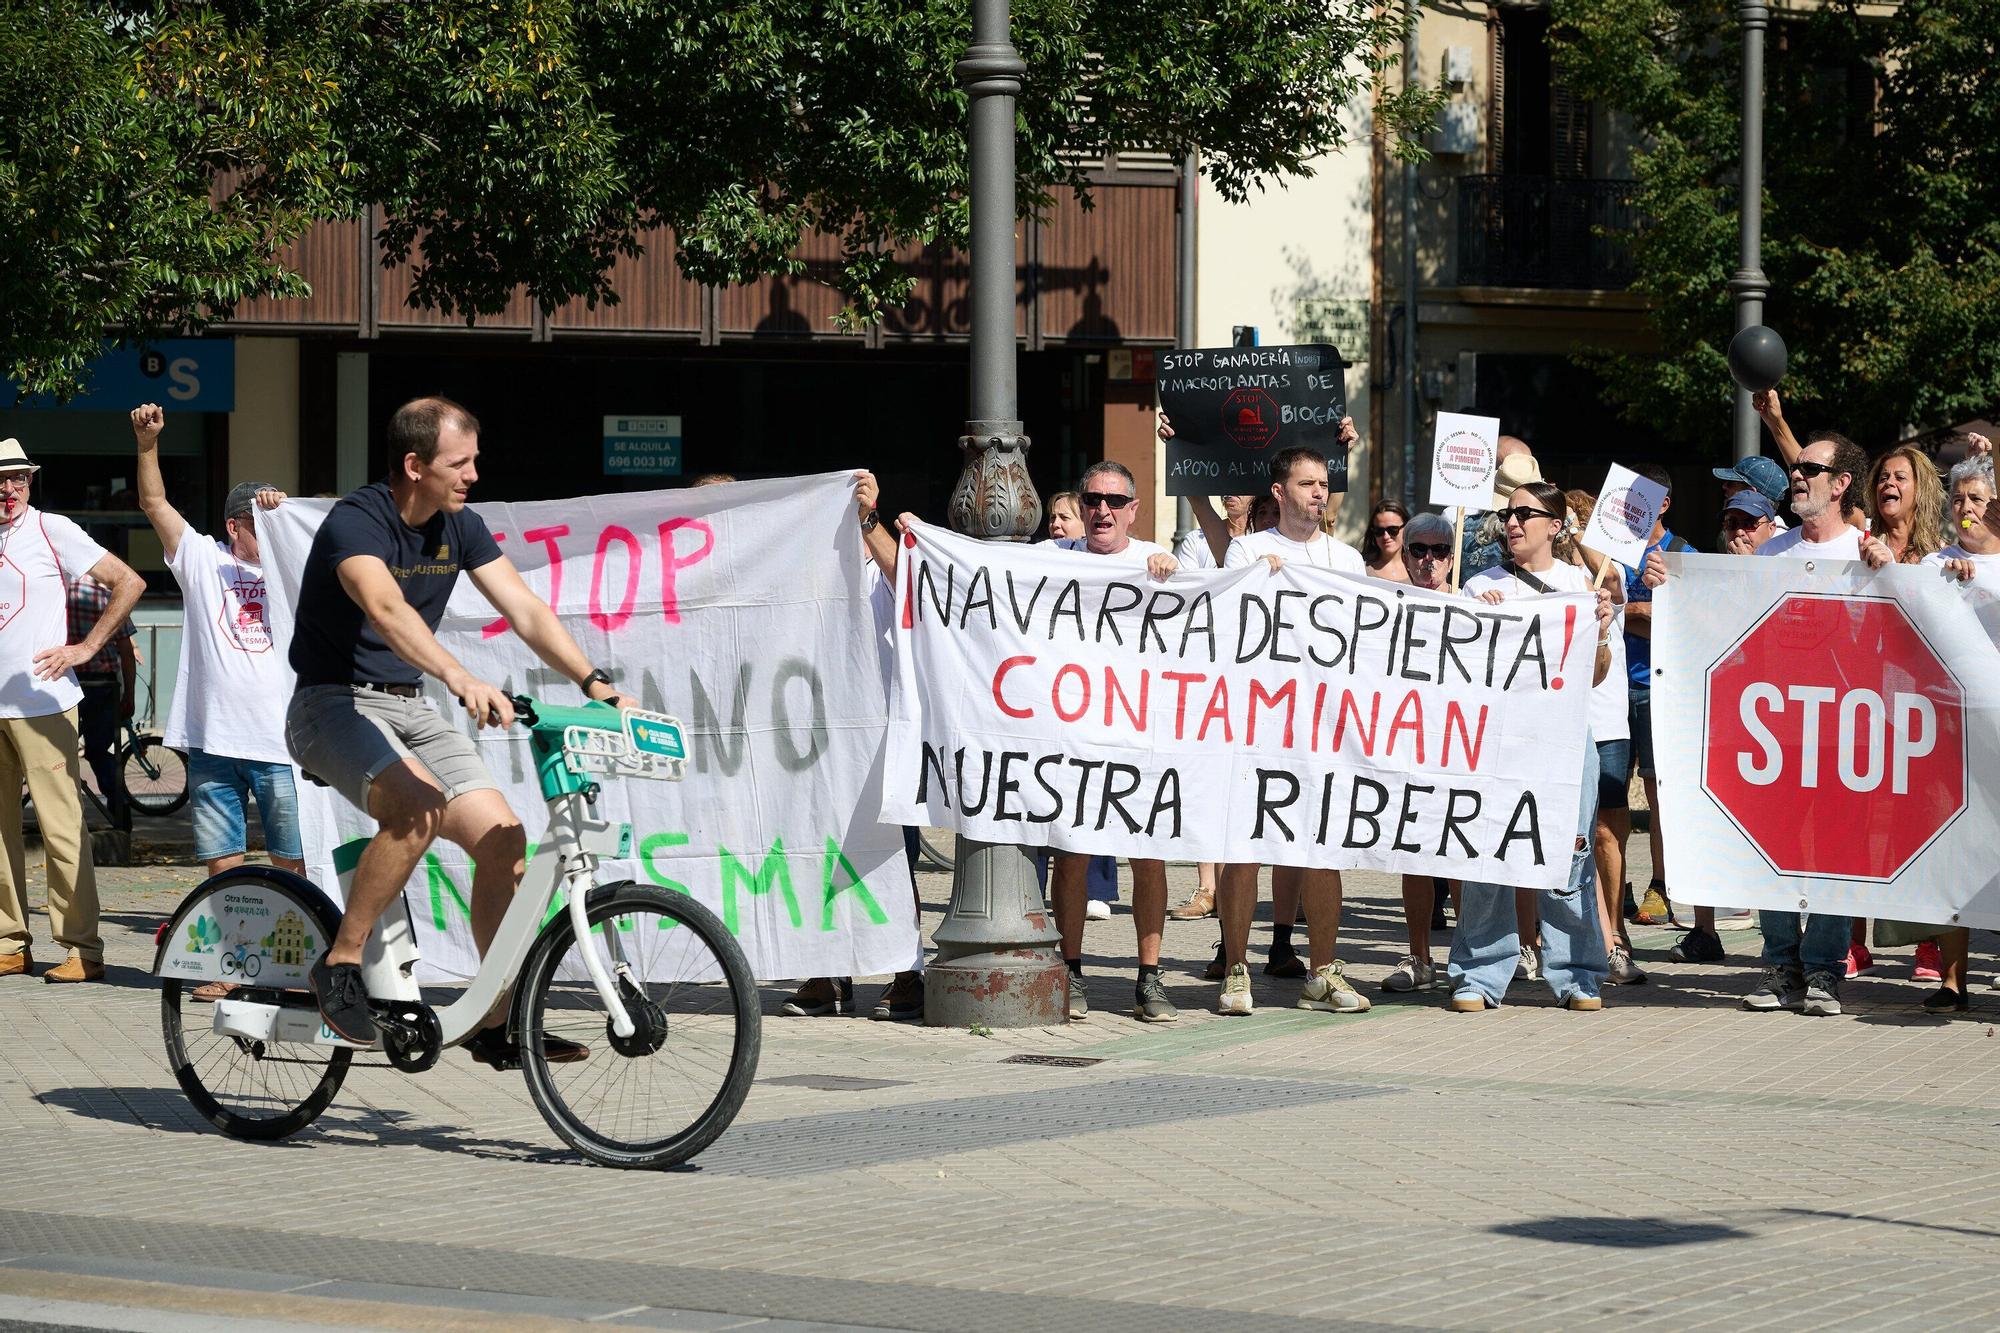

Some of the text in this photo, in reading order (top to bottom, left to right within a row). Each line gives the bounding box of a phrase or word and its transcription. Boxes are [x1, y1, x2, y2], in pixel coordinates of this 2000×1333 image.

[1163, 353, 1204, 370] STOP
[1213, 347, 1291, 369] GANADERÍA
[1159, 374, 1334, 393] Y MACROPLANTAS DE
[1235, 395, 1262, 404] STOP
[1281, 397, 1345, 425] BIOGÁS
[613, 441, 671, 452] SE ALQUILA
[1446, 445, 1485, 457] LODOSA HUELE
[633, 455, 656, 467] 003
[1170, 458, 1220, 477] APOYO
[1228, 461, 1248, 476] AL
[1630, 505, 1647, 519] HUELE
[992, 656, 1489, 772] CONTAMINAN
[1737, 681, 1937, 795] STOP
[915, 741, 1546, 866] NUESTRA RIBERA
[224, 894, 264, 905] Otra forma
[223, 904, 234, 913] de
